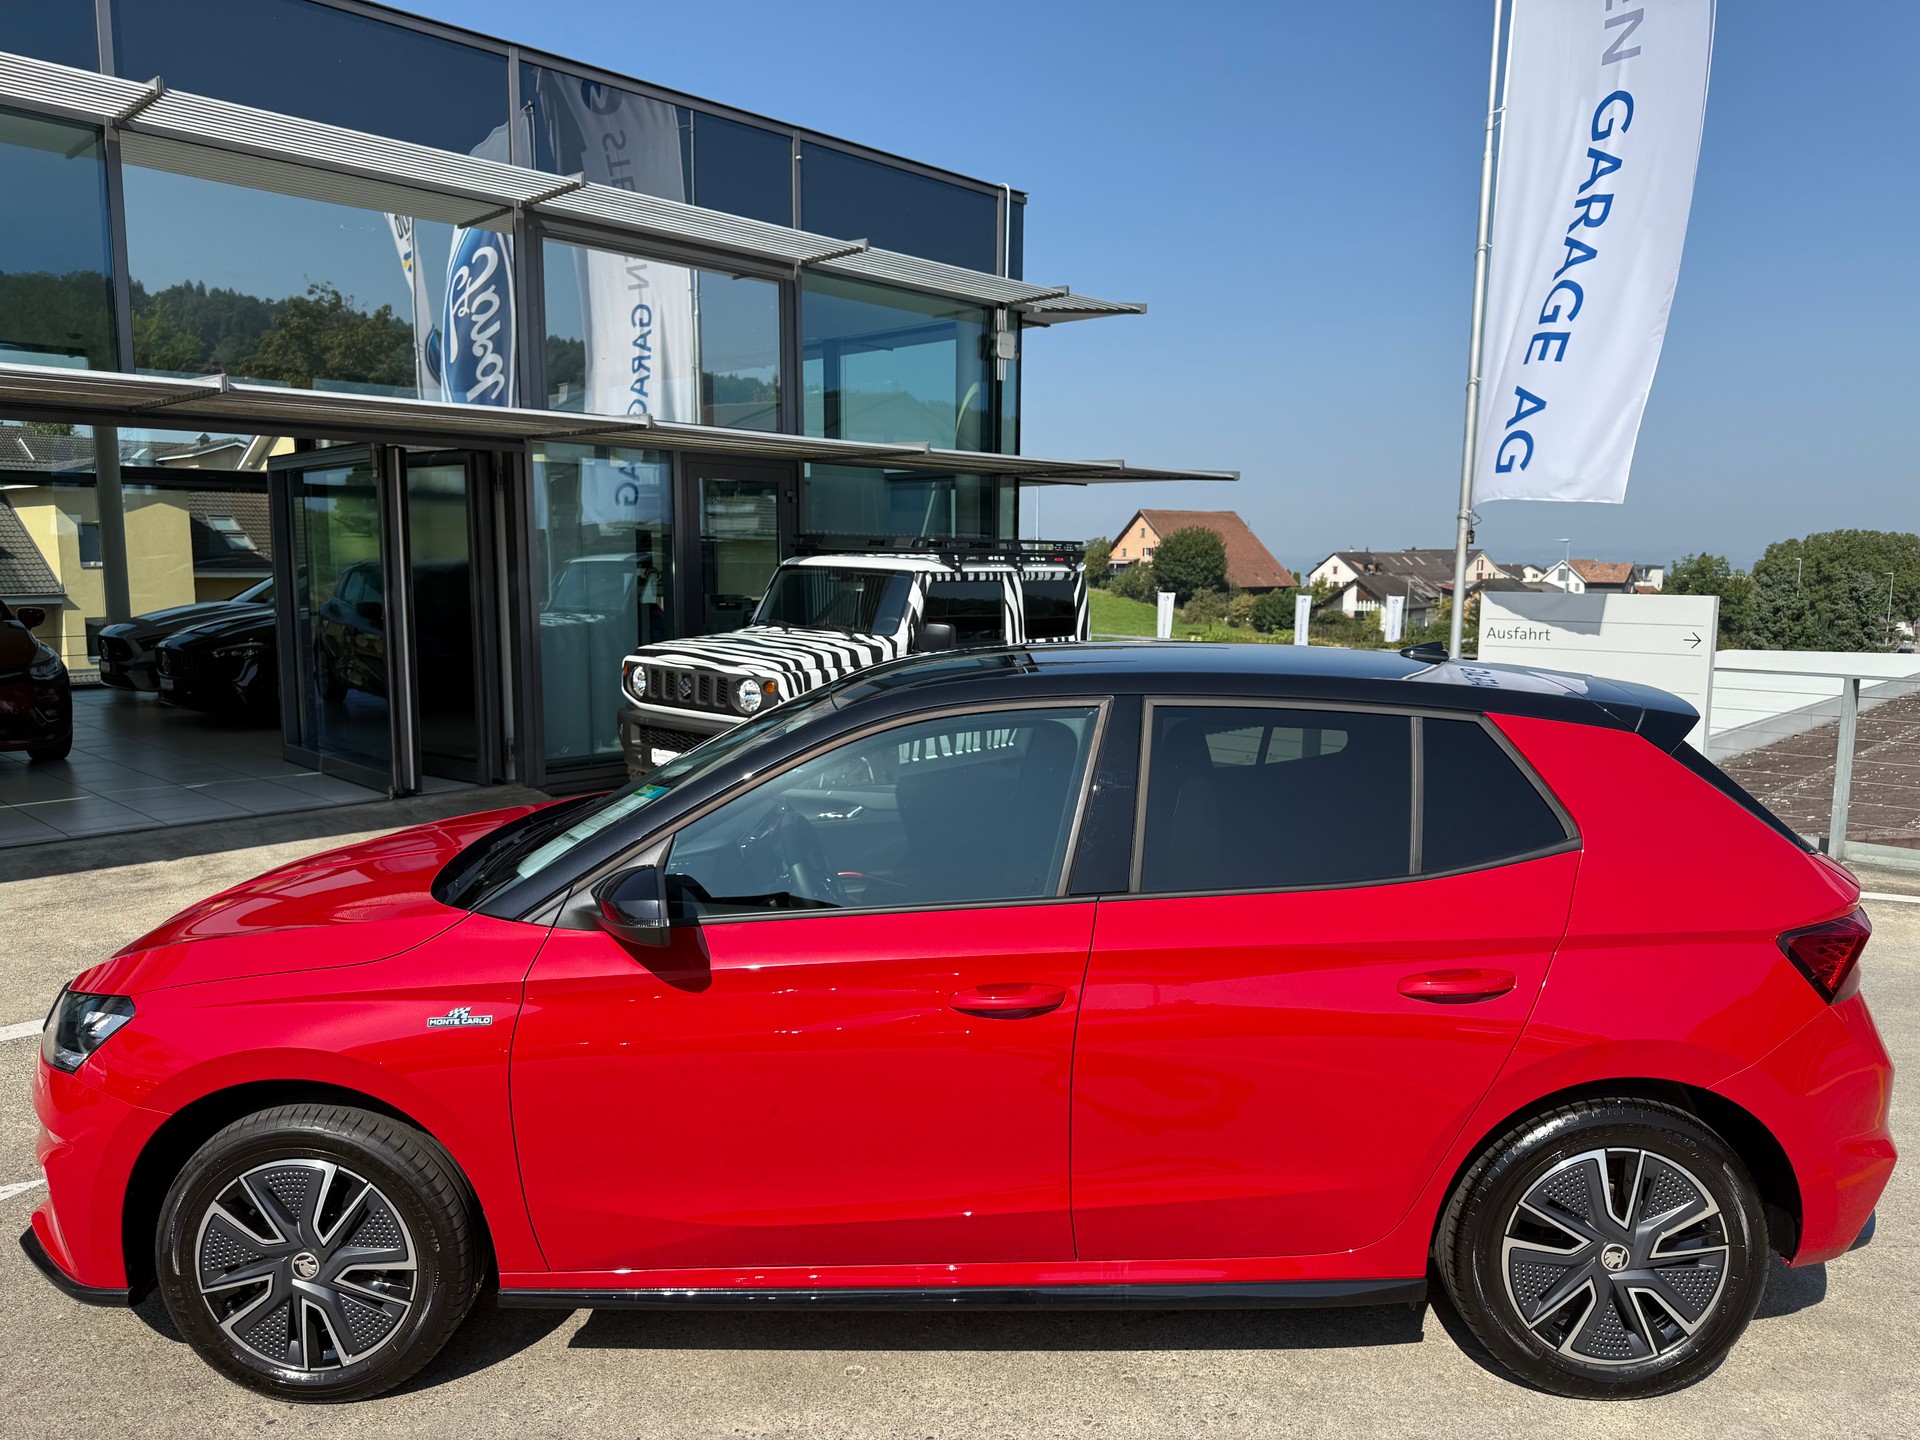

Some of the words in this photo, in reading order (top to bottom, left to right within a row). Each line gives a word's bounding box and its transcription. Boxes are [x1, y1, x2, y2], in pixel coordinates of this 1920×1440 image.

[1523, 90, 1635, 365] GARAGE
[1495, 385, 1547, 474] AG
[1486, 626, 1551, 641] Ausfahrt
[429, 1018, 460, 1026] MONTE
[461, 1017, 491, 1025] CARLO
